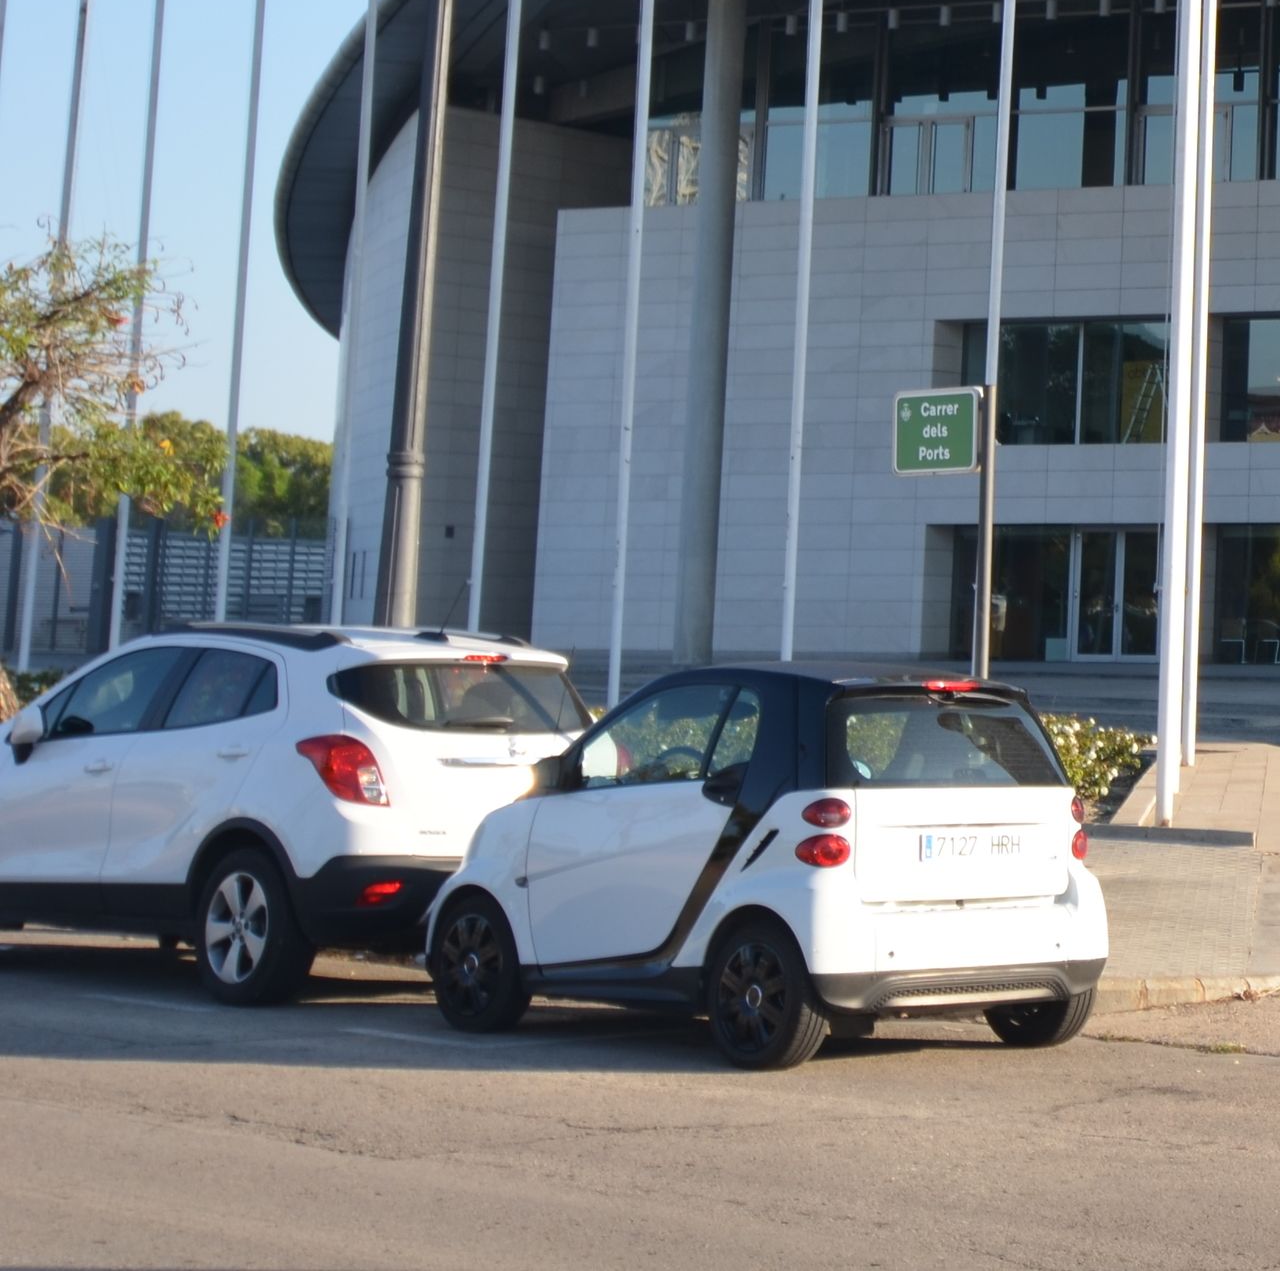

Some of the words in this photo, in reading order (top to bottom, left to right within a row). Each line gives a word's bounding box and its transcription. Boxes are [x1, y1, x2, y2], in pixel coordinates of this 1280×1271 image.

[920, 402, 959, 417] Carrer
[922, 423, 949, 438] dels
[918, 445, 951, 461] Ports
[937, 835, 978, 857] 7127
[990, 835, 1021, 856] HRH
